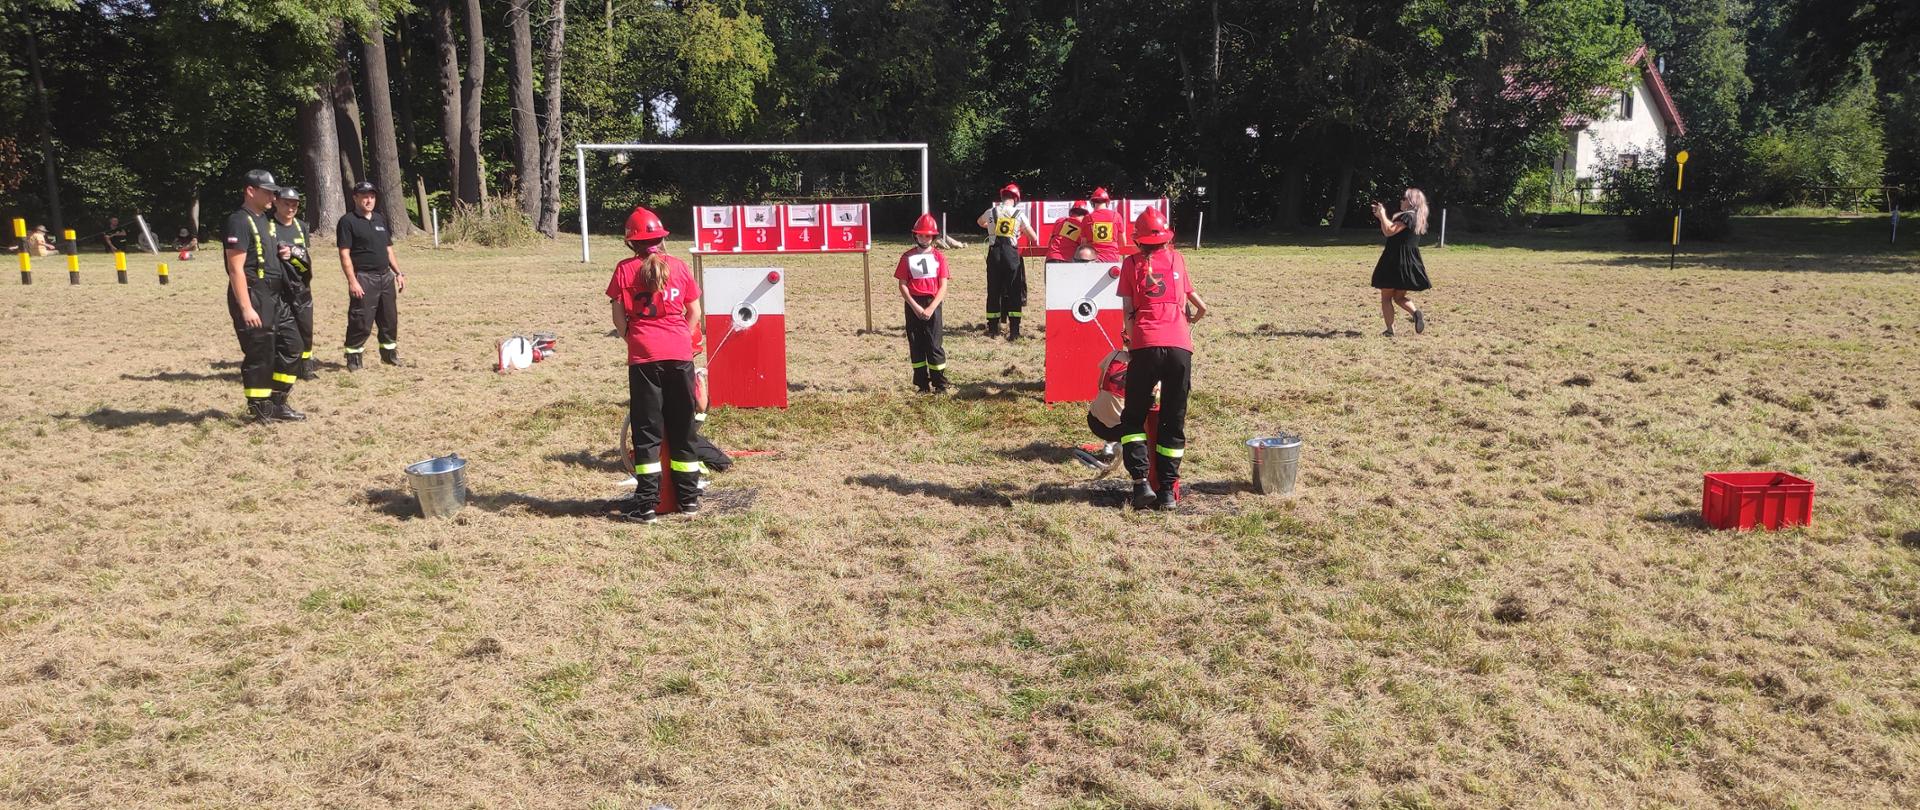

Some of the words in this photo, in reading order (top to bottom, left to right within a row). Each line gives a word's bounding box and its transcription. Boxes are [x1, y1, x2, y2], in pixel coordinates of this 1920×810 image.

[842, 227, 853, 242] 5
[1000, 221, 1010, 234] 6
[1066, 225, 1078, 235] 7
[1097, 225, 1108, 239] 8
[713, 229, 724, 243] 2
[756, 228, 767, 243] 3
[799, 228, 810, 242] 4
[916, 257, 929, 275] 1
[1145, 273, 1167, 298] 5
[634, 291, 657, 318] 3
